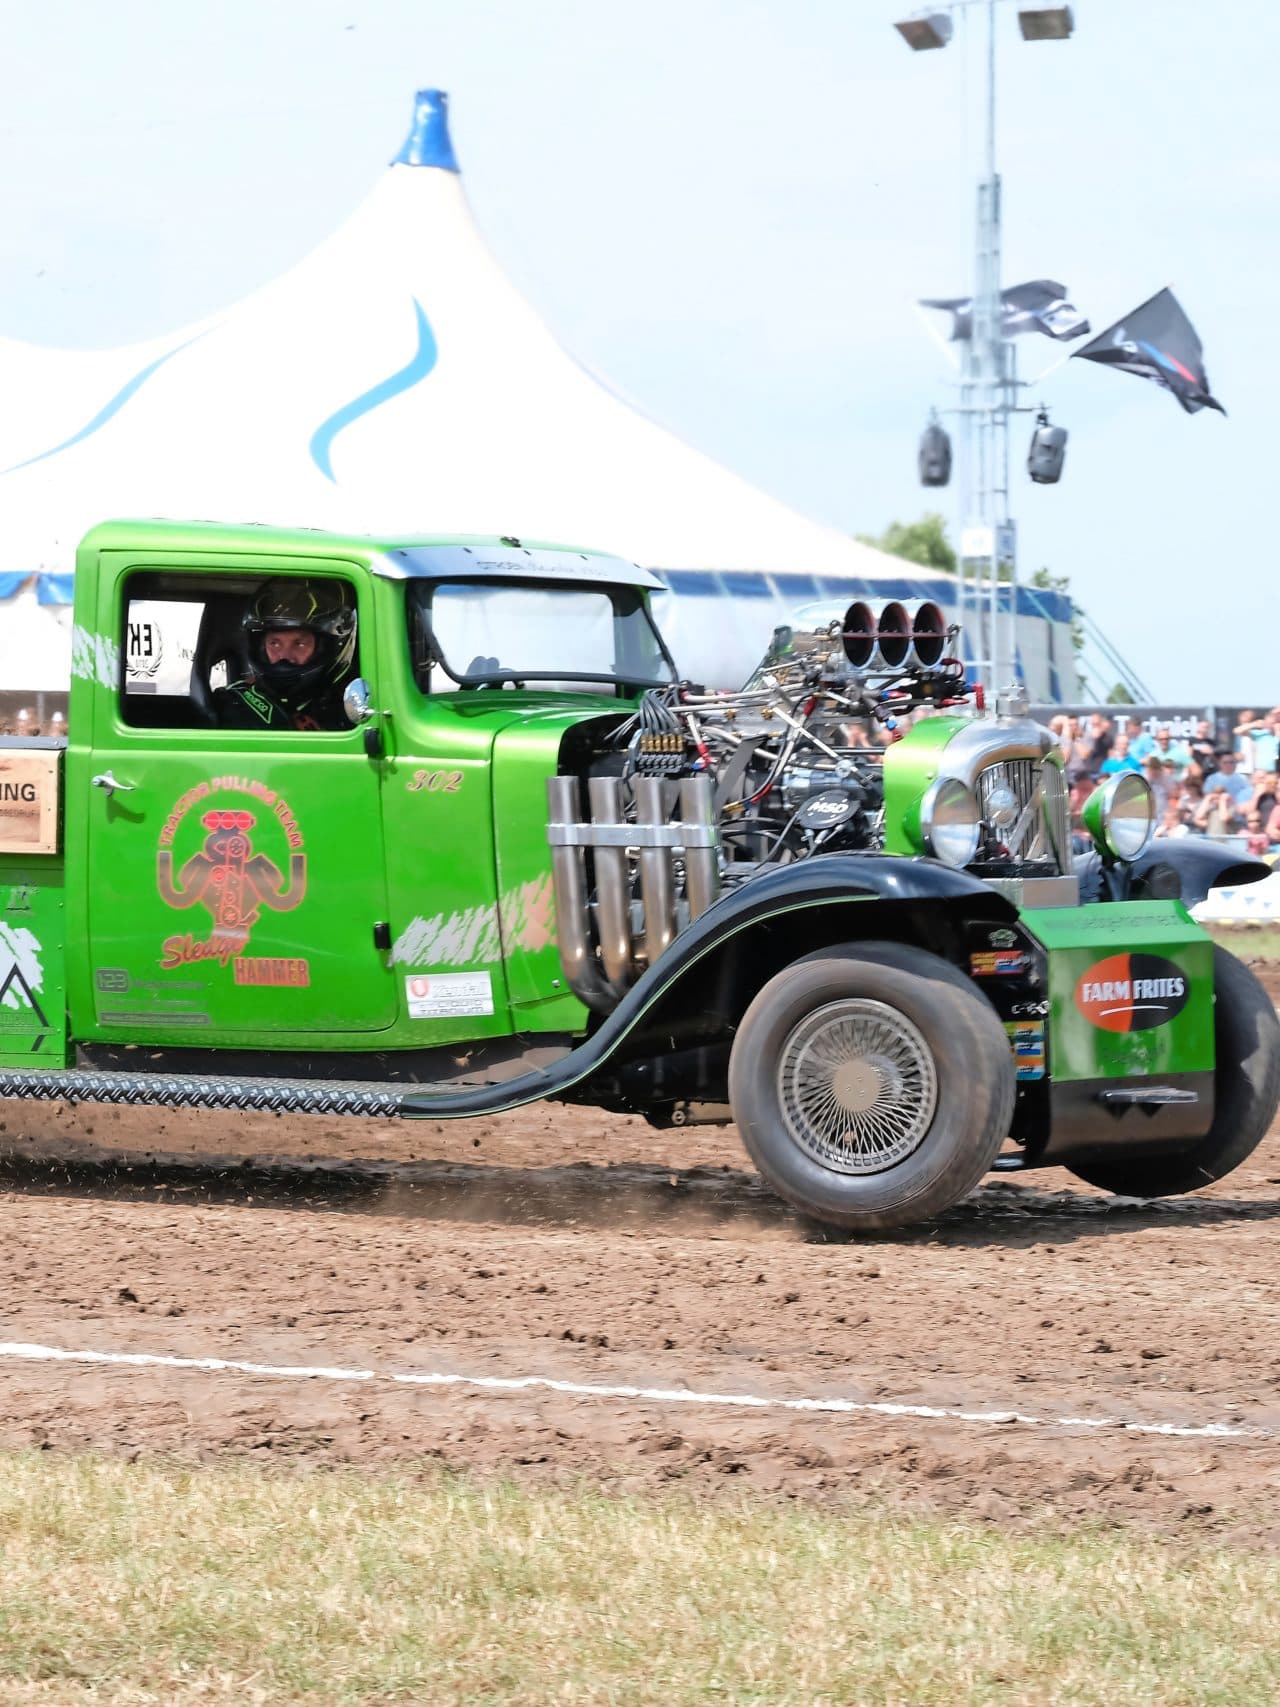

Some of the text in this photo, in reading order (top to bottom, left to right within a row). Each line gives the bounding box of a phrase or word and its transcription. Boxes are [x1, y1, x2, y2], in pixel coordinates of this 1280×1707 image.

[407, 770, 464, 792] 302
[159, 775, 304, 848] TRACTOR PULLING TEAM
[806, 801, 849, 813] MSD
[234, 957, 310, 986] HAMMER
[1082, 977, 1185, 1002] FARM FRITES
